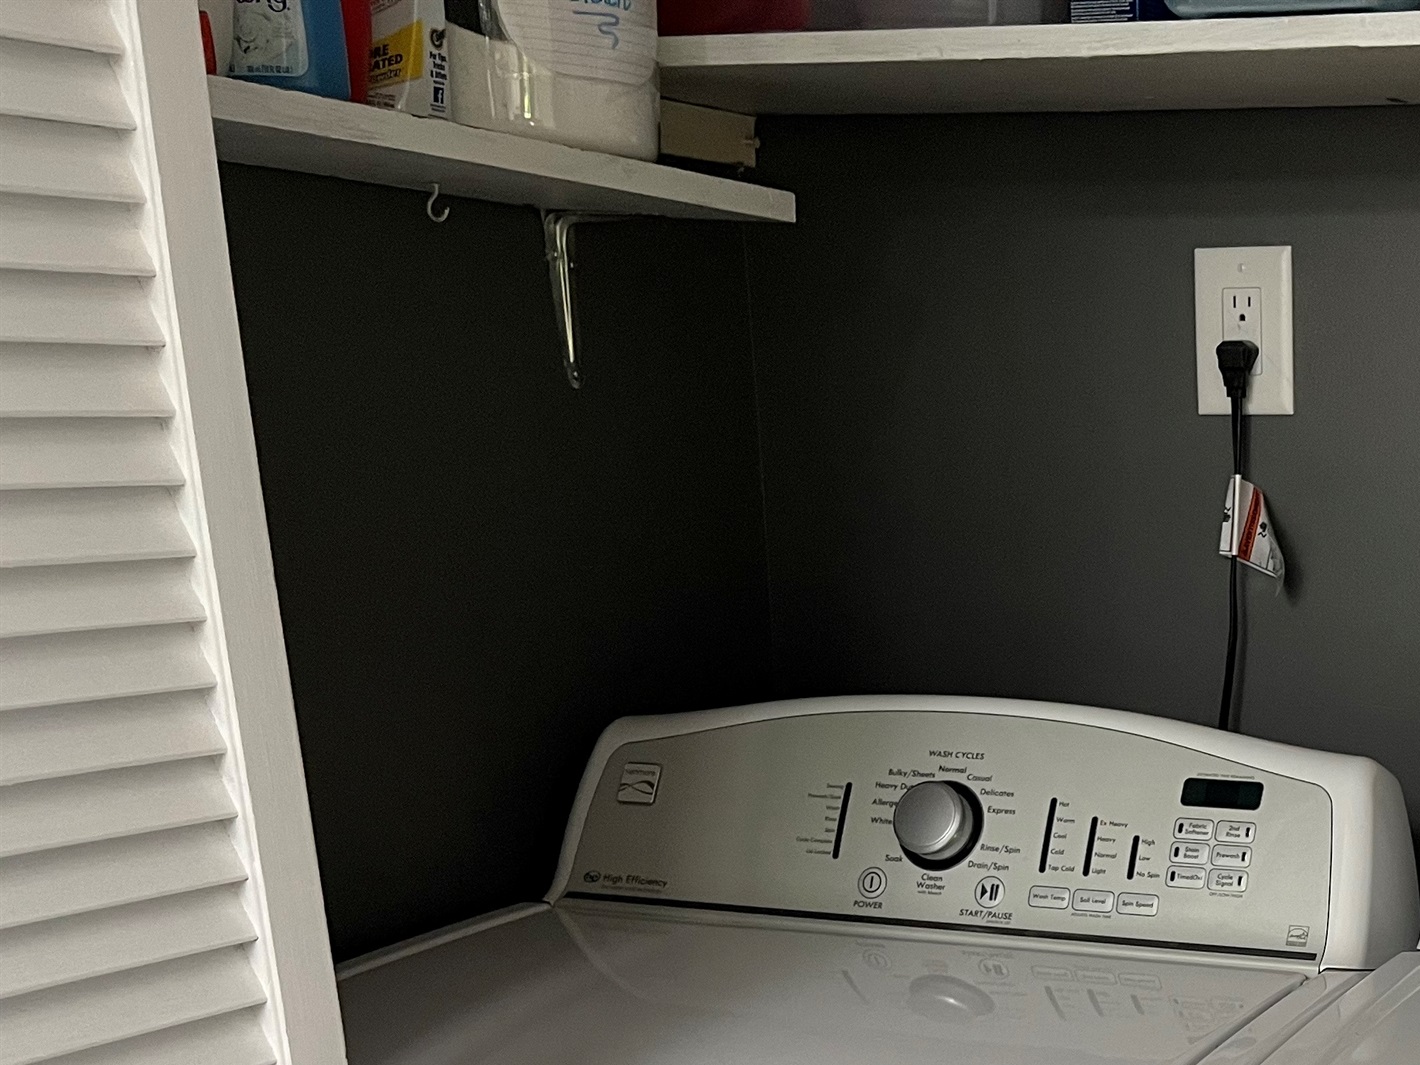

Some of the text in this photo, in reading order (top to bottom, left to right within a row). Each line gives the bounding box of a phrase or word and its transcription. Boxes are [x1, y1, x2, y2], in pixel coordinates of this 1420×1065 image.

[929, 750, 985, 760] WASH CYCLES
[888, 768, 936, 779] Bulky/Sheets
[938, 765, 967, 774] Normal
[967, 774, 993, 782] Casual
[875, 782, 898, 790] Heavy
[980, 788, 1015, 798] Delicates
[987, 806, 1016, 816] Express
[1056, 816, 1076, 824] Warm
[1109, 820, 1128, 828] Heavy
[1097, 836, 1117, 844] Heavy
[1142, 838, 1156, 847] High
[980, 843, 1021, 854] Rinse/Spin
[1050, 848, 1065, 856] Cold
[885, 854, 903, 862] Soak
[968, 860, 1010, 872] Drain/Spin
[1048, 864, 1059, 872] Tap
[602, 874, 623, 884] High
[625, 874, 668, 888] Efficiency
[921, 873, 943, 882] Clean
[916, 881, 946, 890] Washer
[1216, 880, 1234, 888] Signal
[1033, 892, 1066, 902] Wash Temp
[1080, 896, 1090, 904] Soil
[853, 900, 883, 909] POWER
[1122, 900, 1134, 908] Spin
[959, 908, 1013, 921] START/PAUSE
